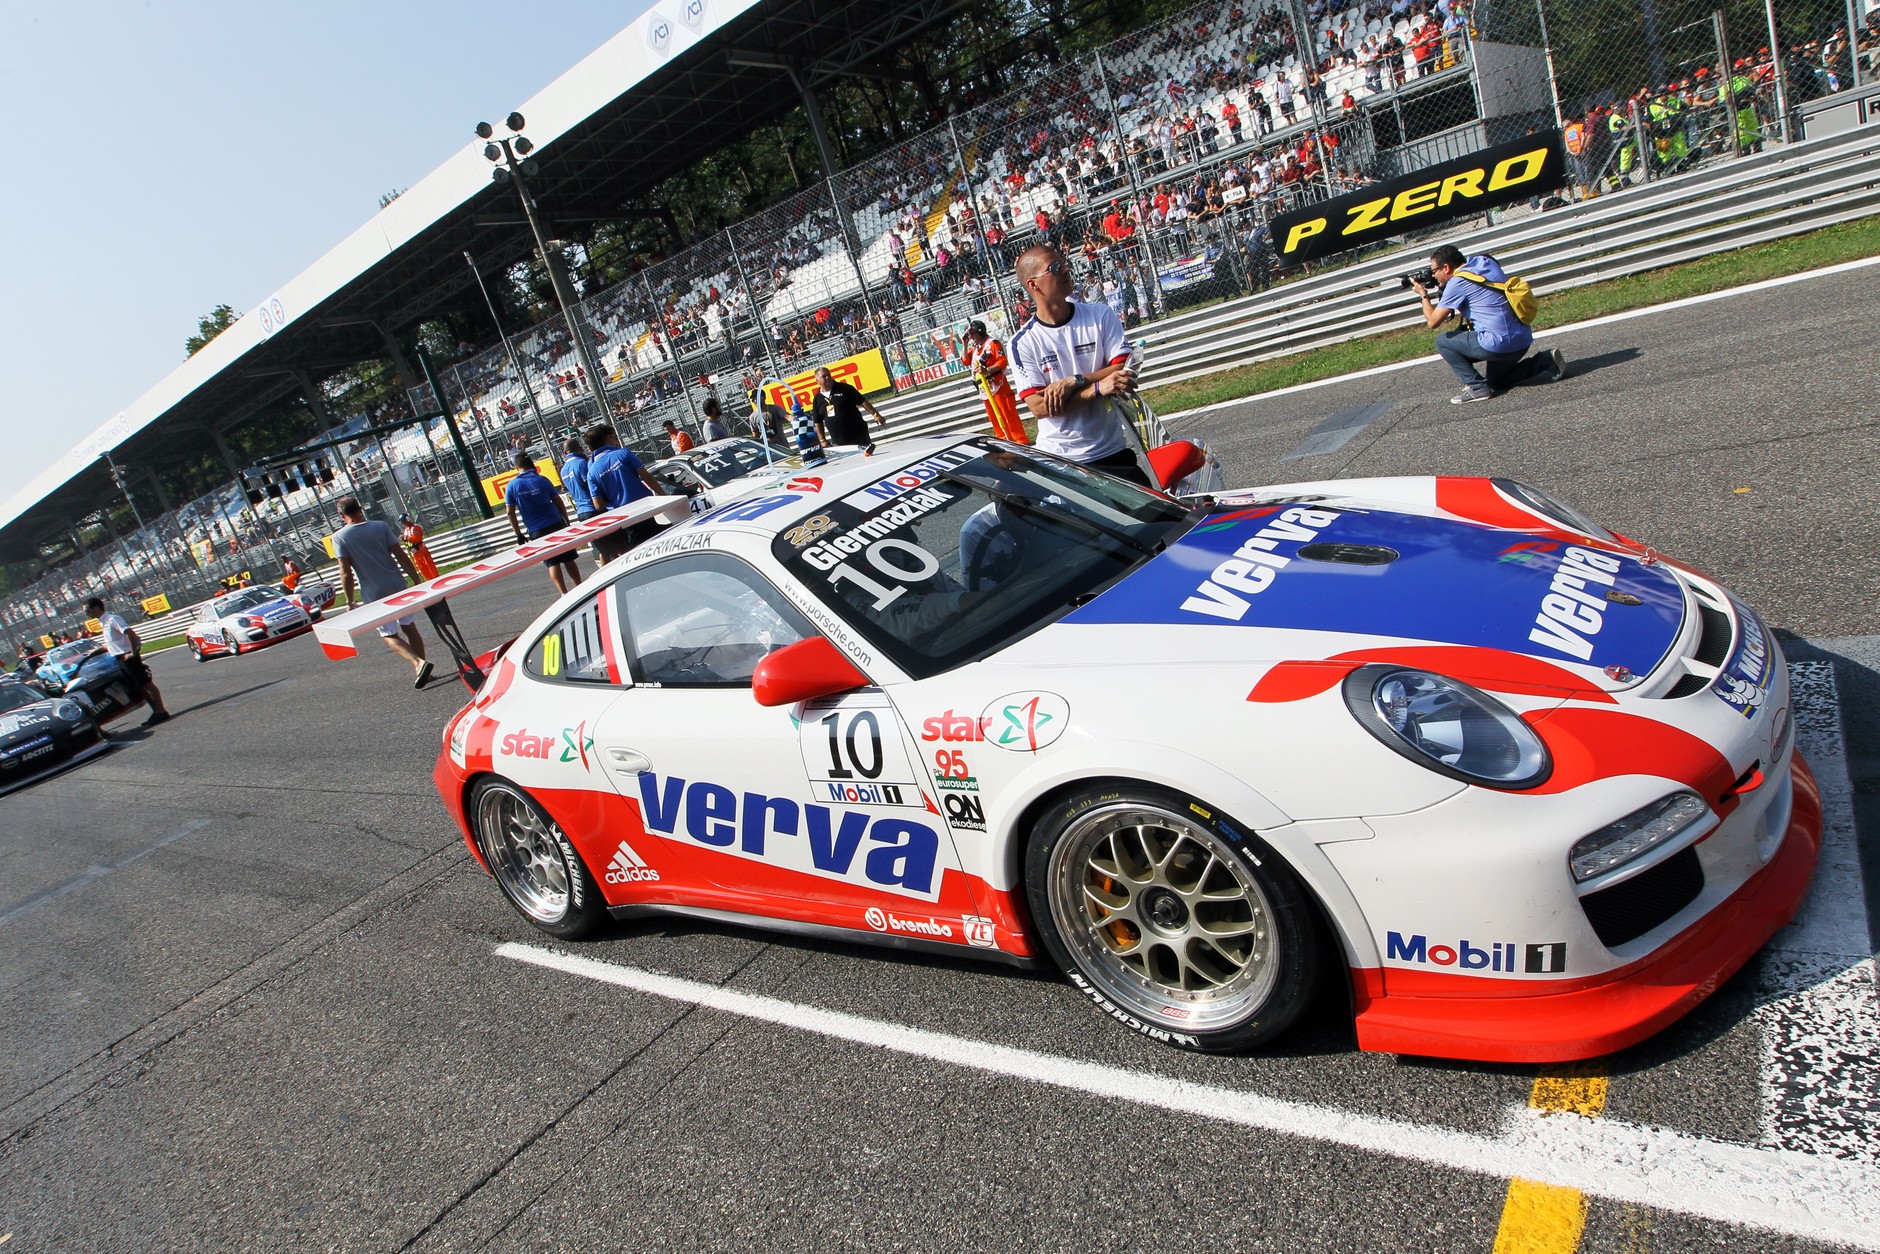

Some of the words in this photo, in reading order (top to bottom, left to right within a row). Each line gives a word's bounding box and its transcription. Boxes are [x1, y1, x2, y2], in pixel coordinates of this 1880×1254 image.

[654, 23, 669, 43] ACI
[1284, 217, 1327, 253] P
[1342, 148, 1548, 235] ZERO
[895, 365, 945, 391] MICHAEL
[705, 459, 731, 473] 41
[864, 460, 951, 501] Mobil
[783, 514, 831, 545] 20
[801, 487, 954, 571] Giermaziak
[384, 515, 629, 606] POLAND
[634, 532, 716, 561] GIERMAZIAK
[827, 538, 940, 612] 10
[1179, 507, 1341, 621] verva
[1528, 546, 1623, 661] verva
[784, 580, 872, 667] www.porsche.com
[543, 633, 560, 676] 10
[921, 708, 993, 742] star
[9, 736, 48, 754] MICHELIN
[22, 743, 54, 761] LOCTITE
[500, 728, 555, 759] star
[821, 710, 884, 780] 10
[935, 749, 969, 780] 95
[828, 782, 882, 803] Mobil
[886, 786, 900, 804] 1
[937, 780, 978, 791] eurosuper
[944, 793, 986, 820] ON
[638, 770, 939, 893] verva
[560, 842, 582, 908] MICHELIN
[605, 866, 660, 884] adidas
[888, 914, 952, 937] brembo
[1387, 931, 1516, 970] Mobil
[1071, 973, 1171, 1043] MICHELIN
[1162, 1006, 1190, 1018] BBS
